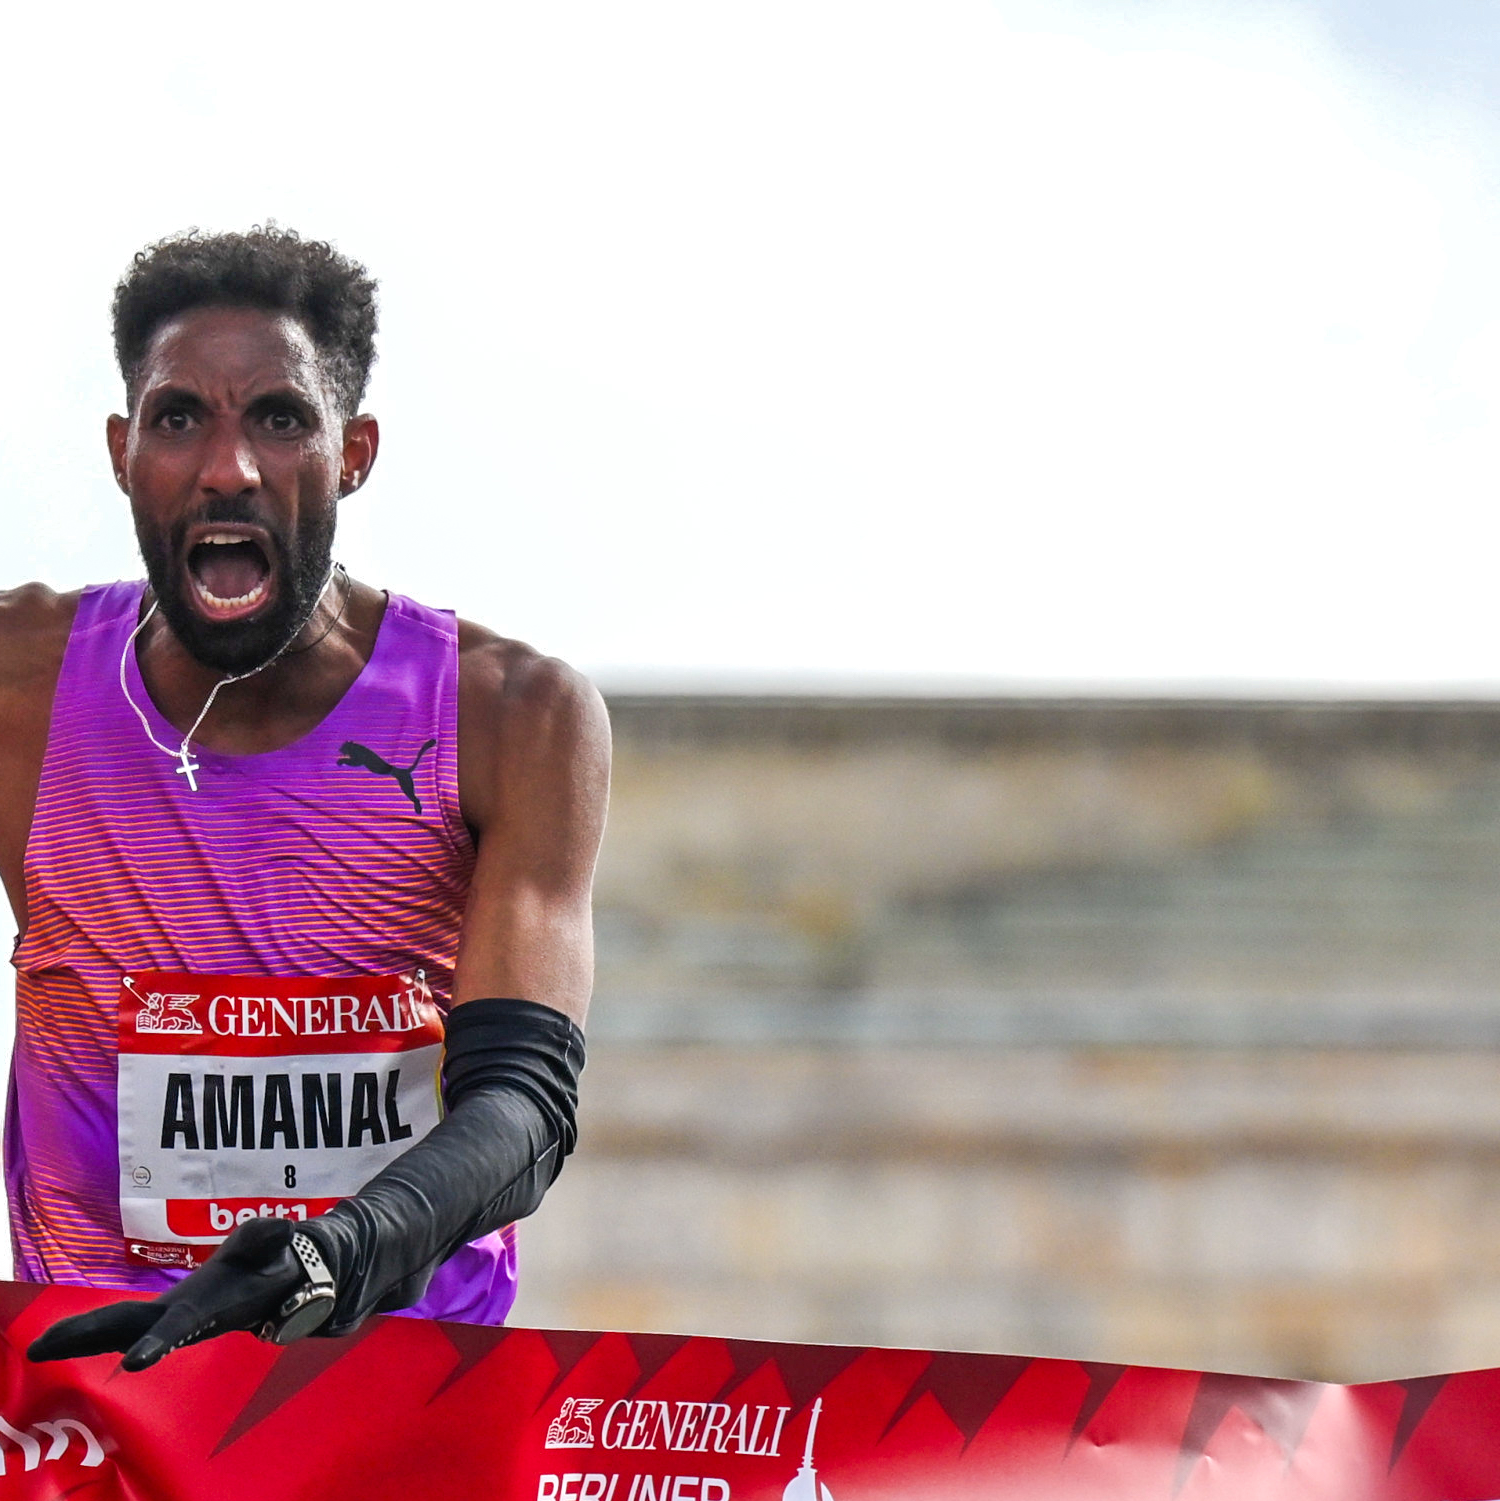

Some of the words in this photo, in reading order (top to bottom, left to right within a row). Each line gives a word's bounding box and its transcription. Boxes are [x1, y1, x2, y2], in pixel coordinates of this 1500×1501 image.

[208, 988, 426, 1038] GENERALI
[160, 1068, 413, 1151] AMANAL
[284, 1164, 297, 1189] 8
[600, 1398, 791, 1457] GENERALI
